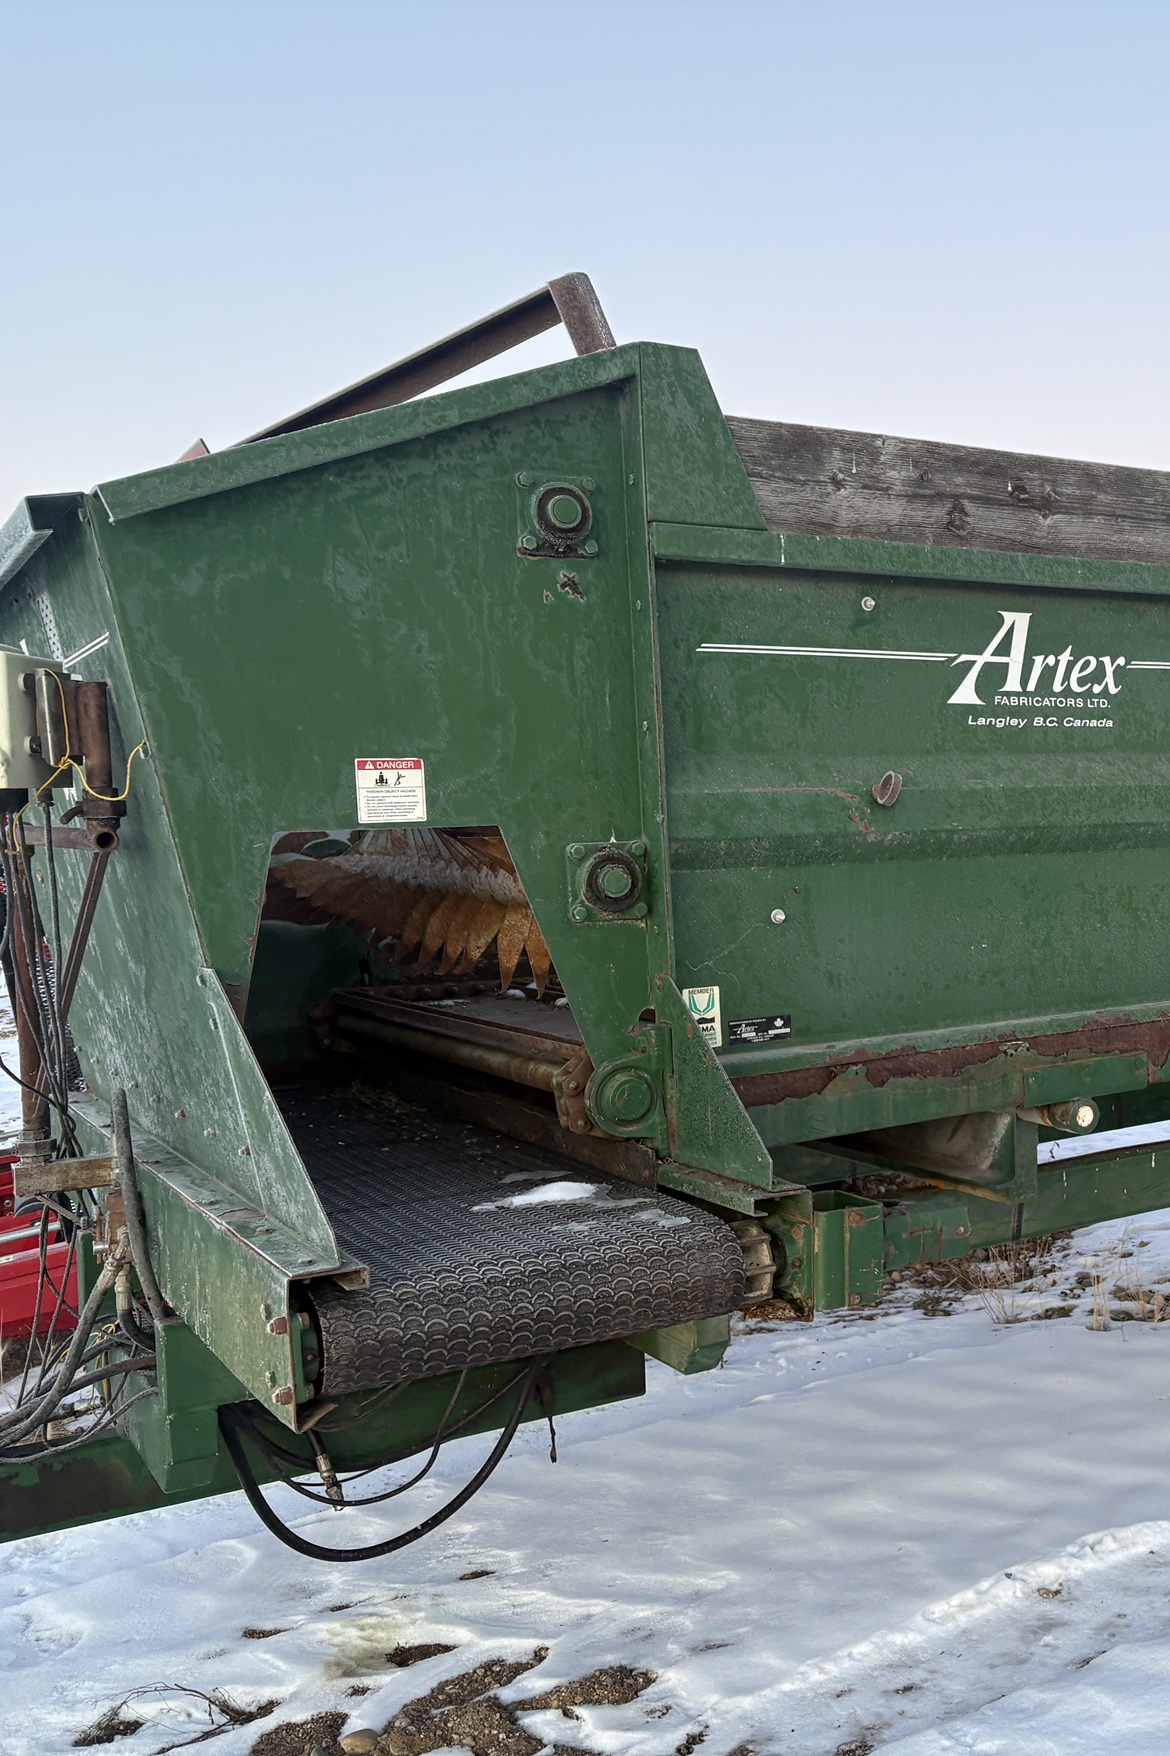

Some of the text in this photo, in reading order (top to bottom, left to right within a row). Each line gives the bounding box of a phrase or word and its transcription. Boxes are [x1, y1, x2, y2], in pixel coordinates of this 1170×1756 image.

[947, 611, 1126, 705] Artex
[994, 695, 1111, 708] FABRICATORS LTD.
[967, 715, 1114, 729] Langley B.C. Canada
[376, 761, 415, 769] DANGER
